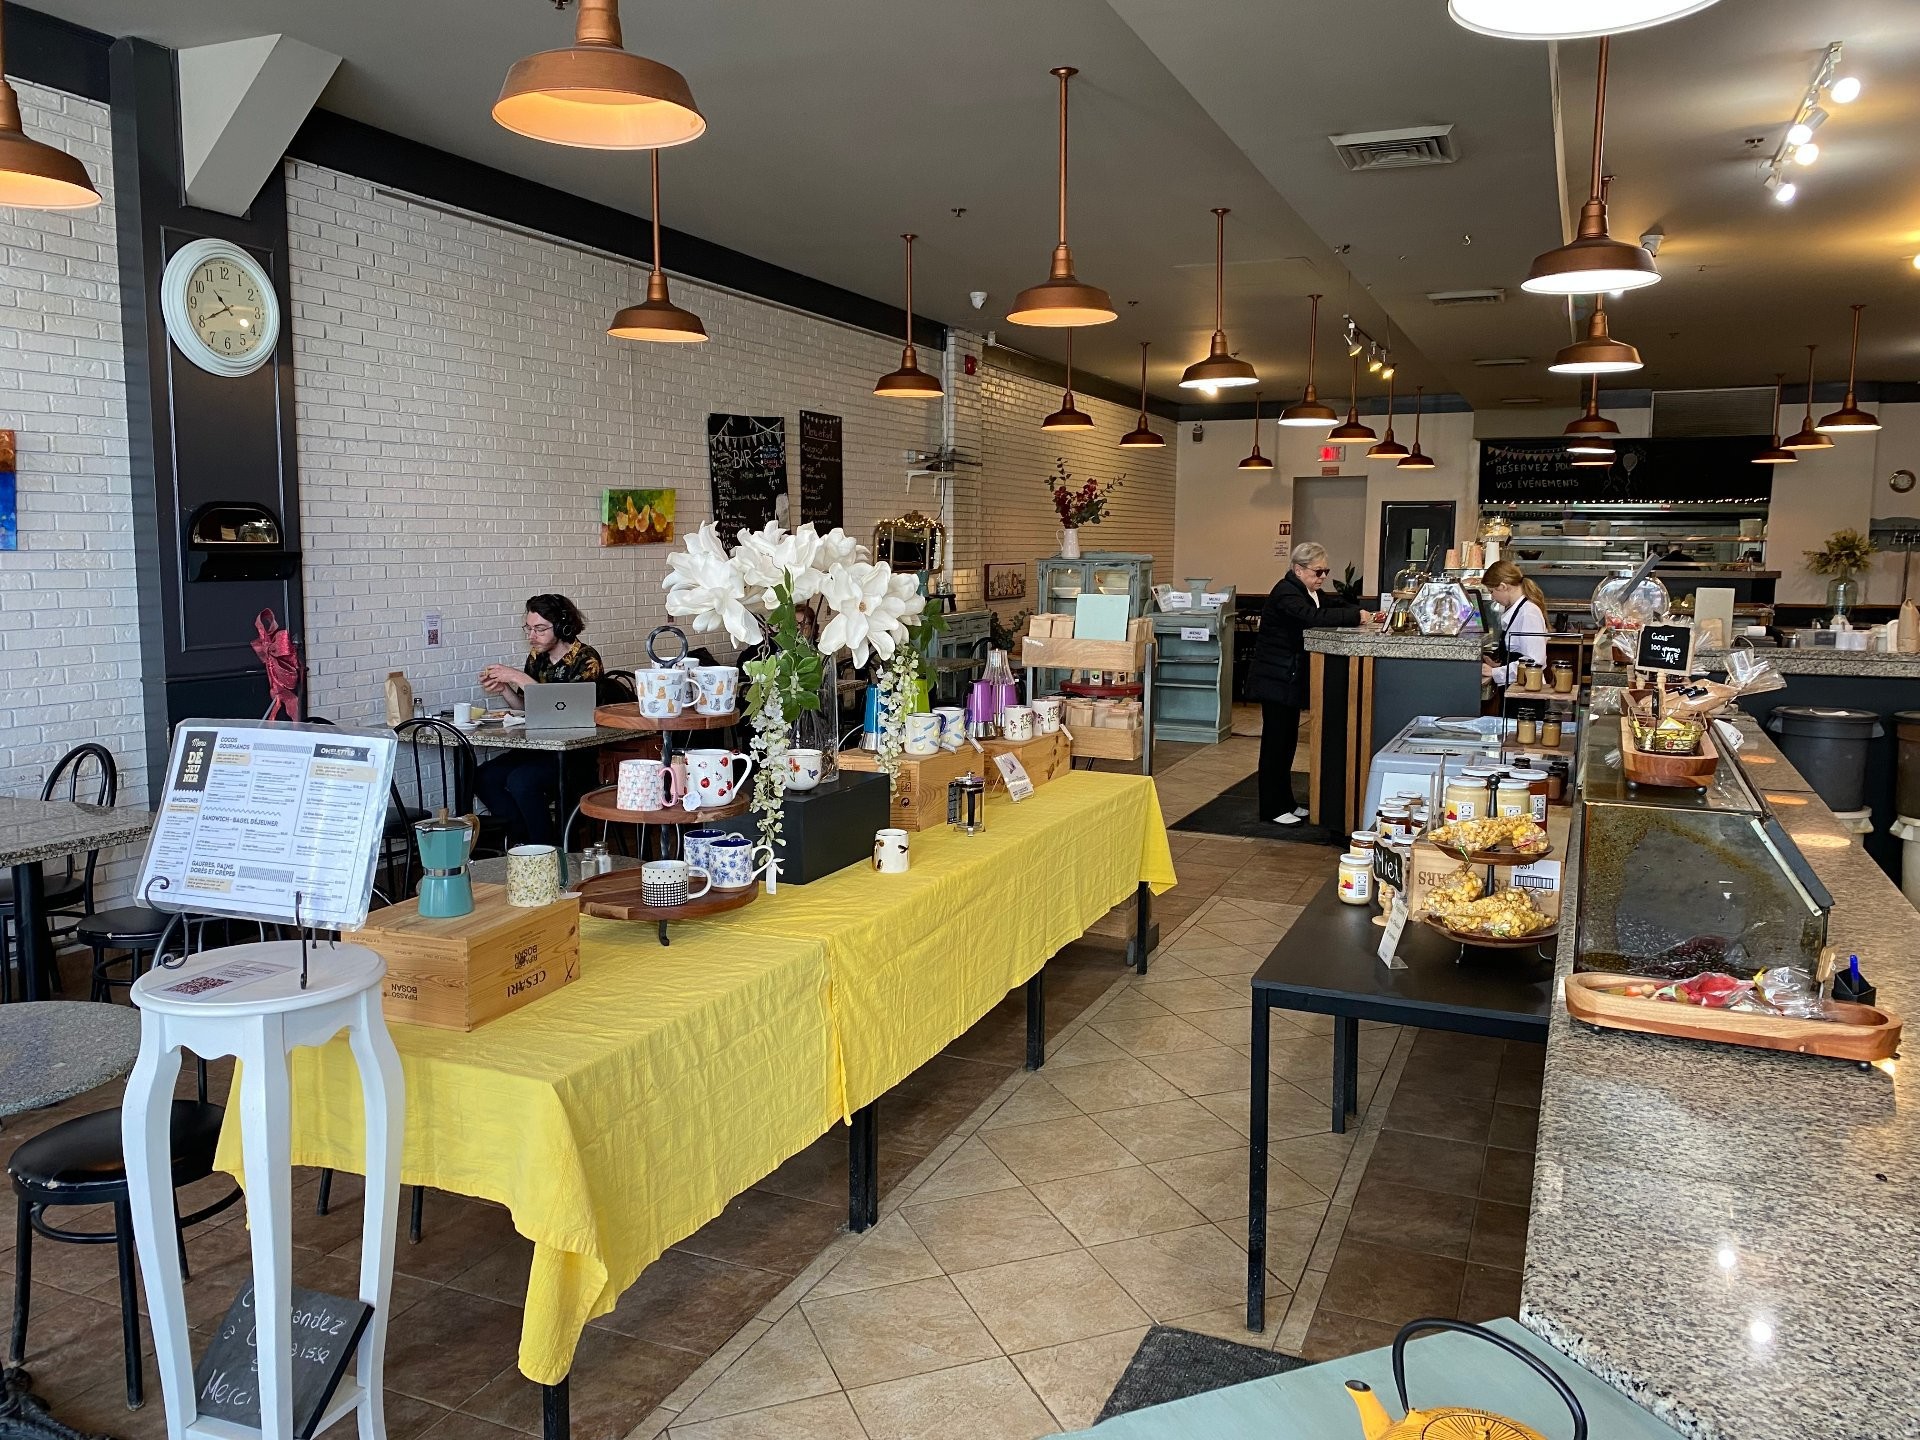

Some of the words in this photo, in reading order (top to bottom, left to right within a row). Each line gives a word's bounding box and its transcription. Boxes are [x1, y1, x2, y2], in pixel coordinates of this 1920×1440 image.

[205, 268, 214, 282] 11
[219, 266, 229, 280] 12
[195, 280, 204, 293] 10
[238, 274, 242, 286] 1
[247, 288, 254, 302] 2
[190, 296, 197, 309] 9
[254, 306, 261, 320] 3
[198, 314, 206, 328] 8
[250, 324, 256, 336] 4
[210, 332, 216, 344] 7
[224, 336, 231, 350] 6
[240, 334, 246, 346] 5
[732, 450, 754, 468] BAR
[1496, 461, 1549, 474] RÉSERVEZ
[1496, 481, 1512, 489] VOS
[188, 748, 204, 764] DÉ
[185, 765, 200, 773] JEU
[182, 774, 198, 783] NER
[250, 818, 278, 827] DÉJEUNER
[514, 944, 538, 962] BOSAN
[391, 984, 417, 993] BOSAN
[507, 970, 546, 998] CESARI
[391, 992, 418, 1000] RIPASSO
[201, 1368, 255, 1406] Merci
